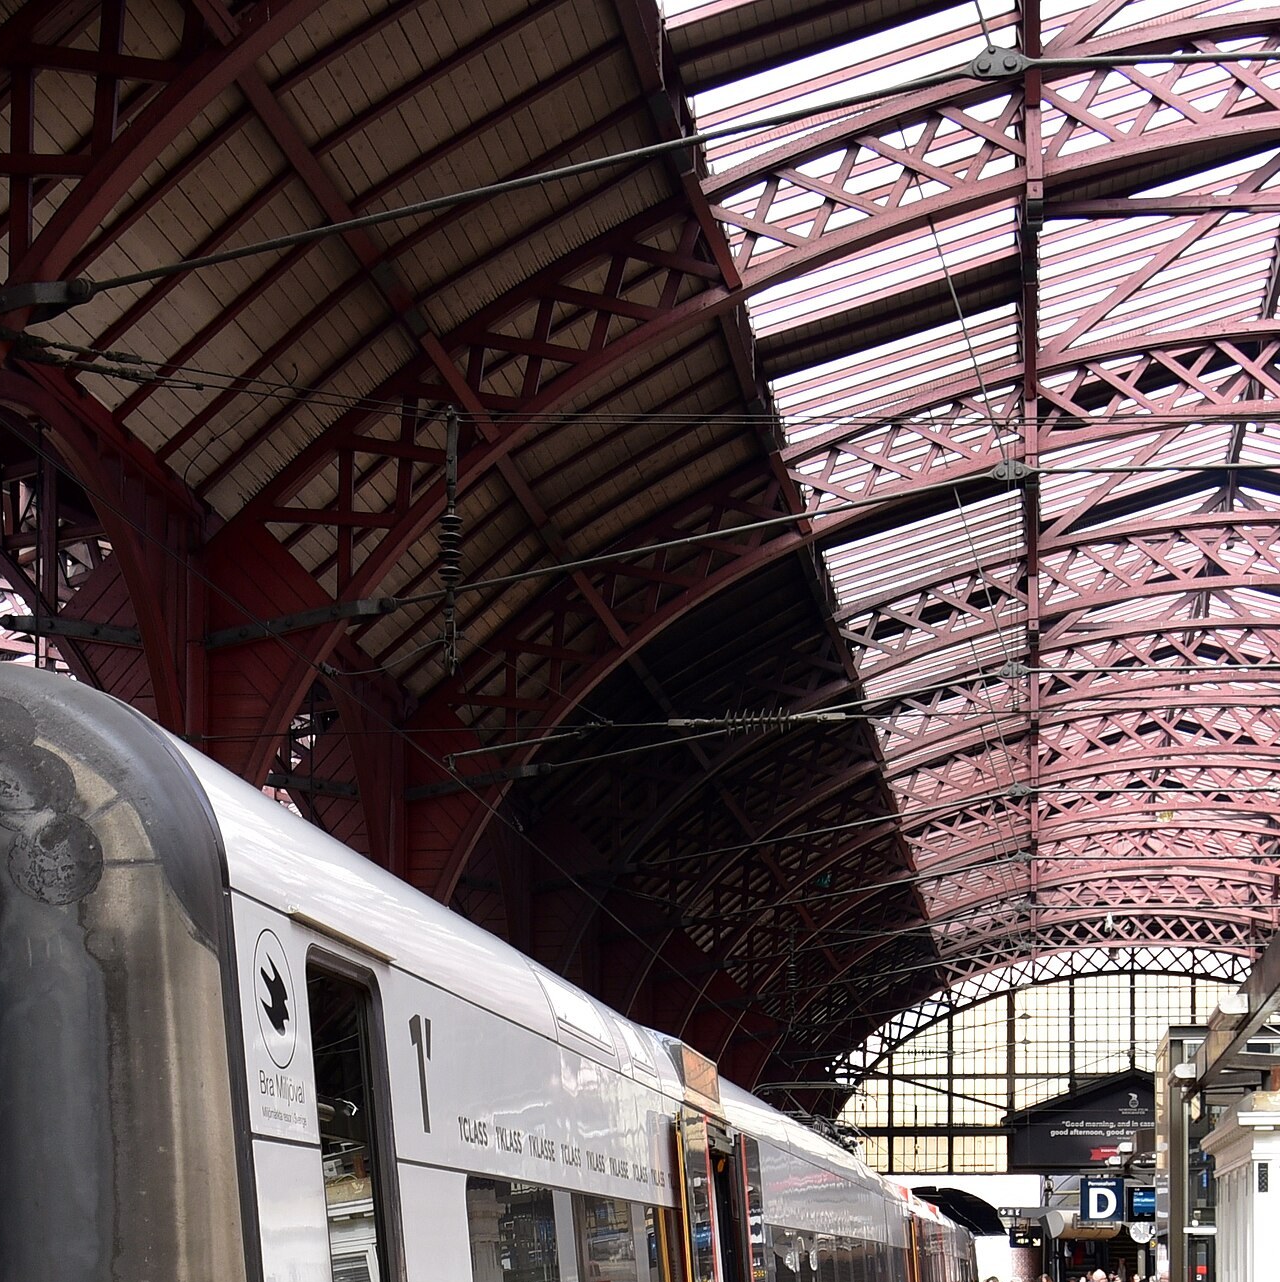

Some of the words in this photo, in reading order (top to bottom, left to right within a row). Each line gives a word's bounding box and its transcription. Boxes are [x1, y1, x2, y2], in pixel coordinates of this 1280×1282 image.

[259, 1069, 275, 1097] Bra
[275, 1073, 306, 1107] Miljöval
[1050, 1129, 1068, 1137] good
[1069, 1129, 1105, 1137] afternoon,
[1106, 1129, 1125, 1137] good
[1085, 1120, 1116, 1129] morning,
[1088, 1187, 1118, 1219] D
